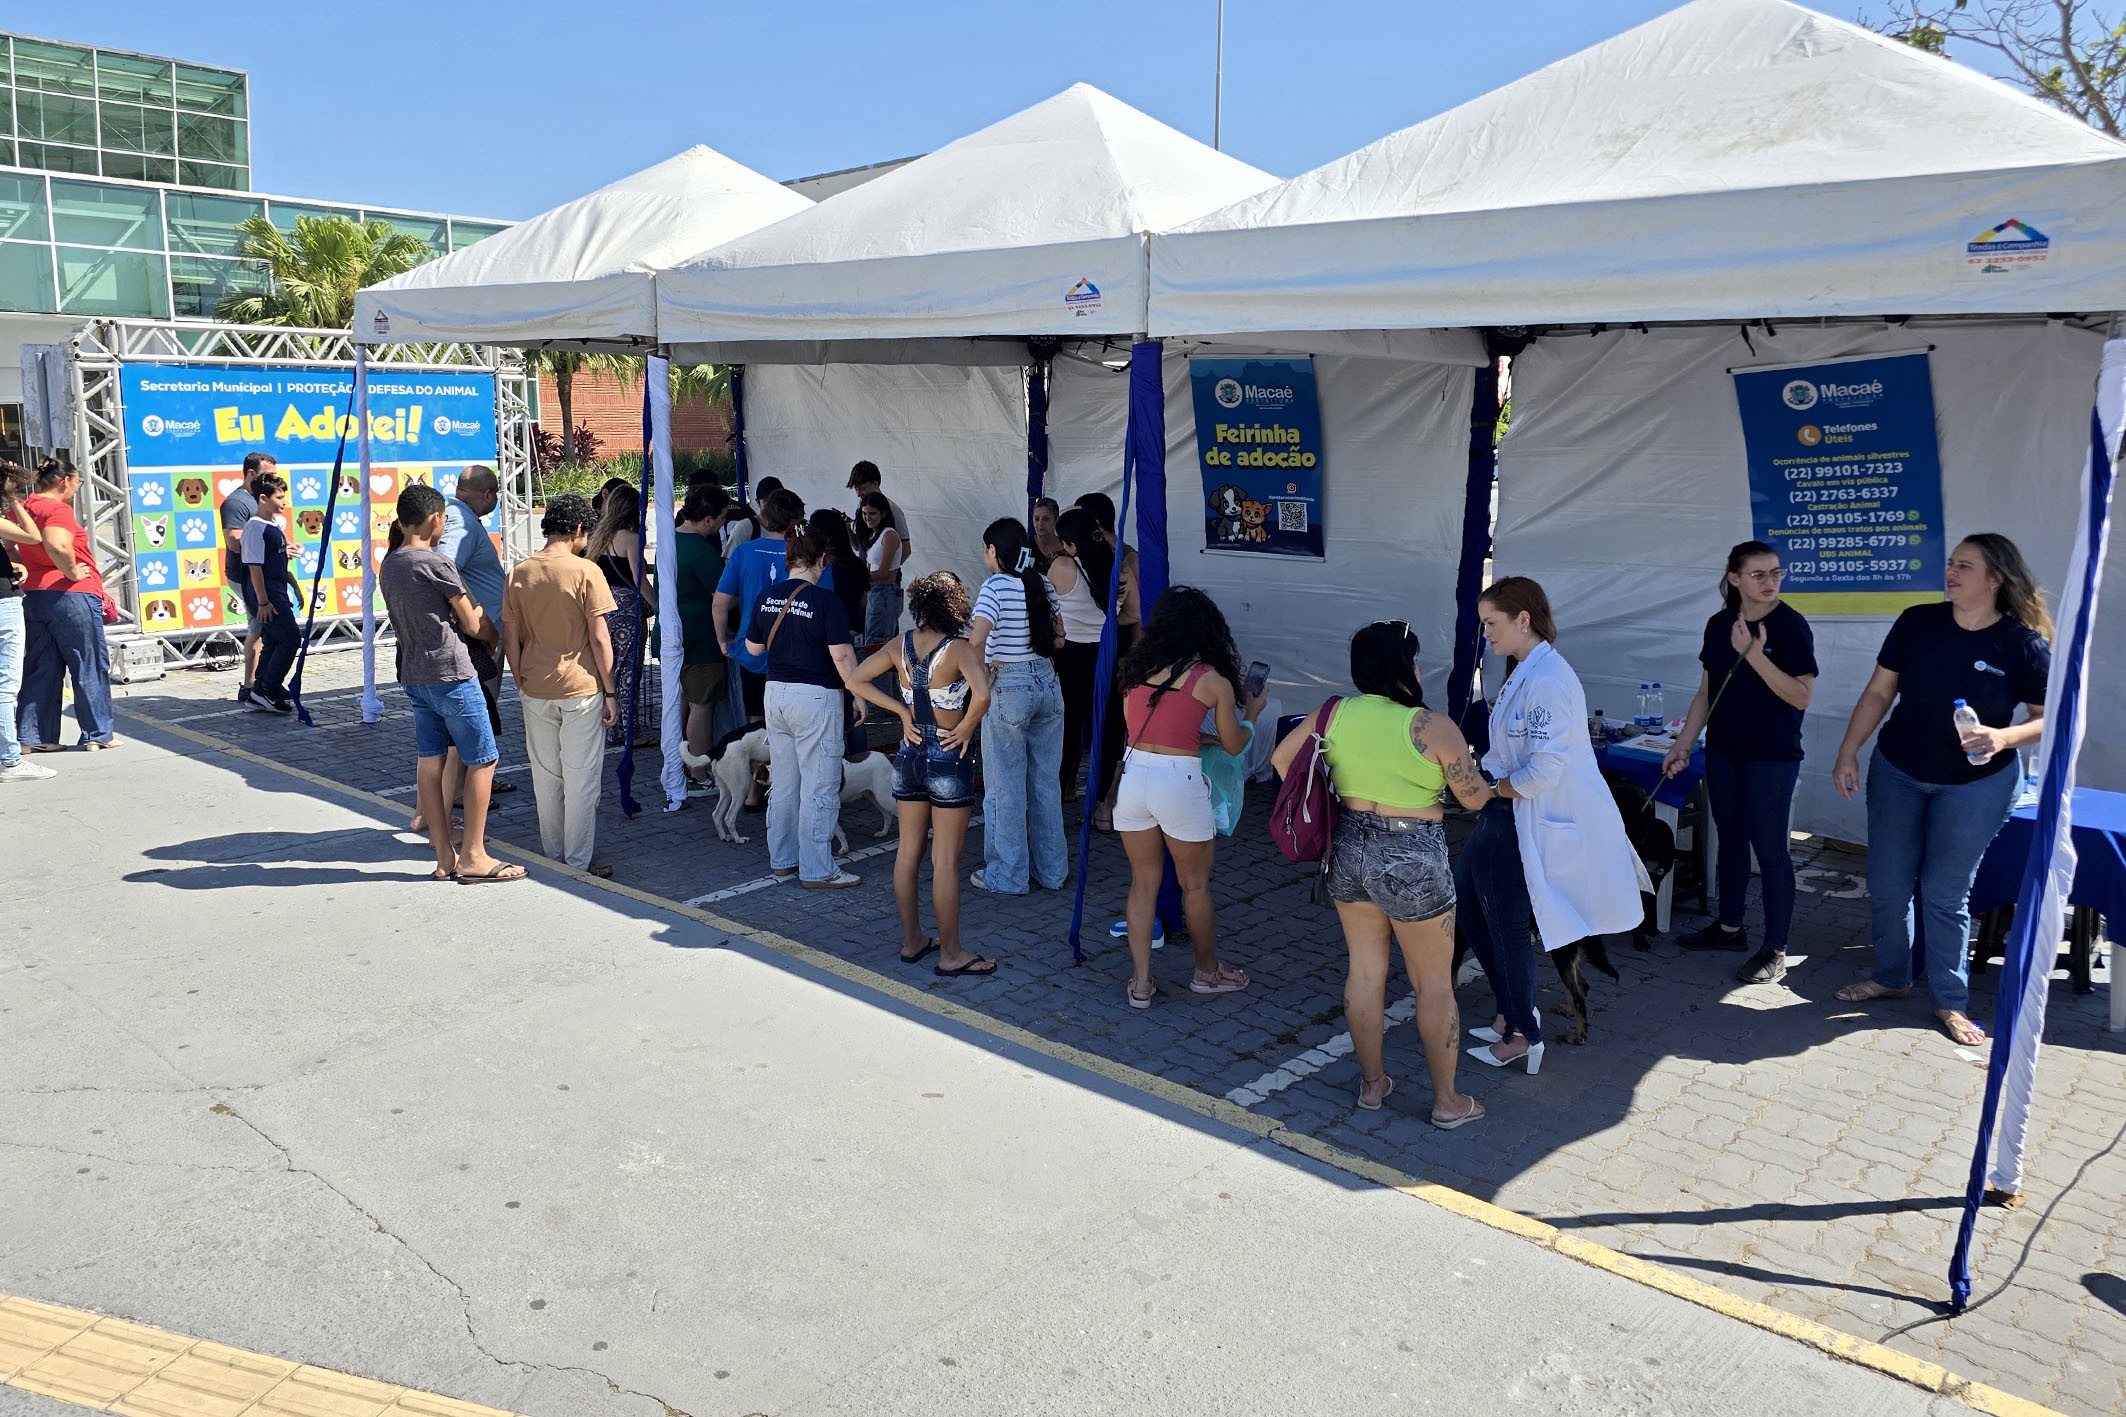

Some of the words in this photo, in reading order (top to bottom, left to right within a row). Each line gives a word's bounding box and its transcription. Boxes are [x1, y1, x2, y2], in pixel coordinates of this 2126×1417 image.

[141, 380, 209, 392] Secretaria
[212, 382, 272, 394] Municipal
[368, 385, 414, 395] DEFESA
[416, 385, 433, 395] DO
[435, 386, 479, 396] ANIMAL
[1245, 385, 1293, 399] Macaé
[1820, 379, 1883, 398] Macaé
[165, 420, 200, 429] Macaé
[214, 406, 265, 443] Eu
[274, 403, 423, 443] Adotei!
[452, 420, 480, 429] Macaé
[1823, 423, 1878, 434] Telefones
[1216, 424, 1300, 443] Feirinha
[1825, 434, 1854, 444] Úteis
[1205, 447, 1231, 466] de
[1237, 446, 1316, 468] adoção
[1773, 457, 1818, 466] Ocorrência
[1820, 455, 1830, 463] de
[1832, 454, 1864, 462] animais
[1867, 451, 1910, 460] silvestres
[1785, 467, 1812, 480] (22)
[1815, 462, 1903, 477] 99101-7323
[1797, 480, 1824, 488] Cavalo
[1857, 477, 1888, 485] pública
[1789, 491, 1817, 503] (22)
[1821, 487, 1898, 500] 2763-6337
[1808, 503, 1848, 511] Castração
[1850, 501, 1880, 509] Animal
[1787, 515, 1813, 527] (22)
[1818, 511, 1905, 524] 99105-1769
[1768, 527, 1809, 536] Denúncias
[1788, 538, 1815, 550] (22)
[1819, 535, 1906, 548] 99285-6779
[1789, 562, 1816, 574] (22)
[1820, 560, 1907, 572] 99105-5937
[766, 597, 798, 607] Secretia
[761, 605, 790, 613] Proteço
[791, 607, 813, 618] Animal
